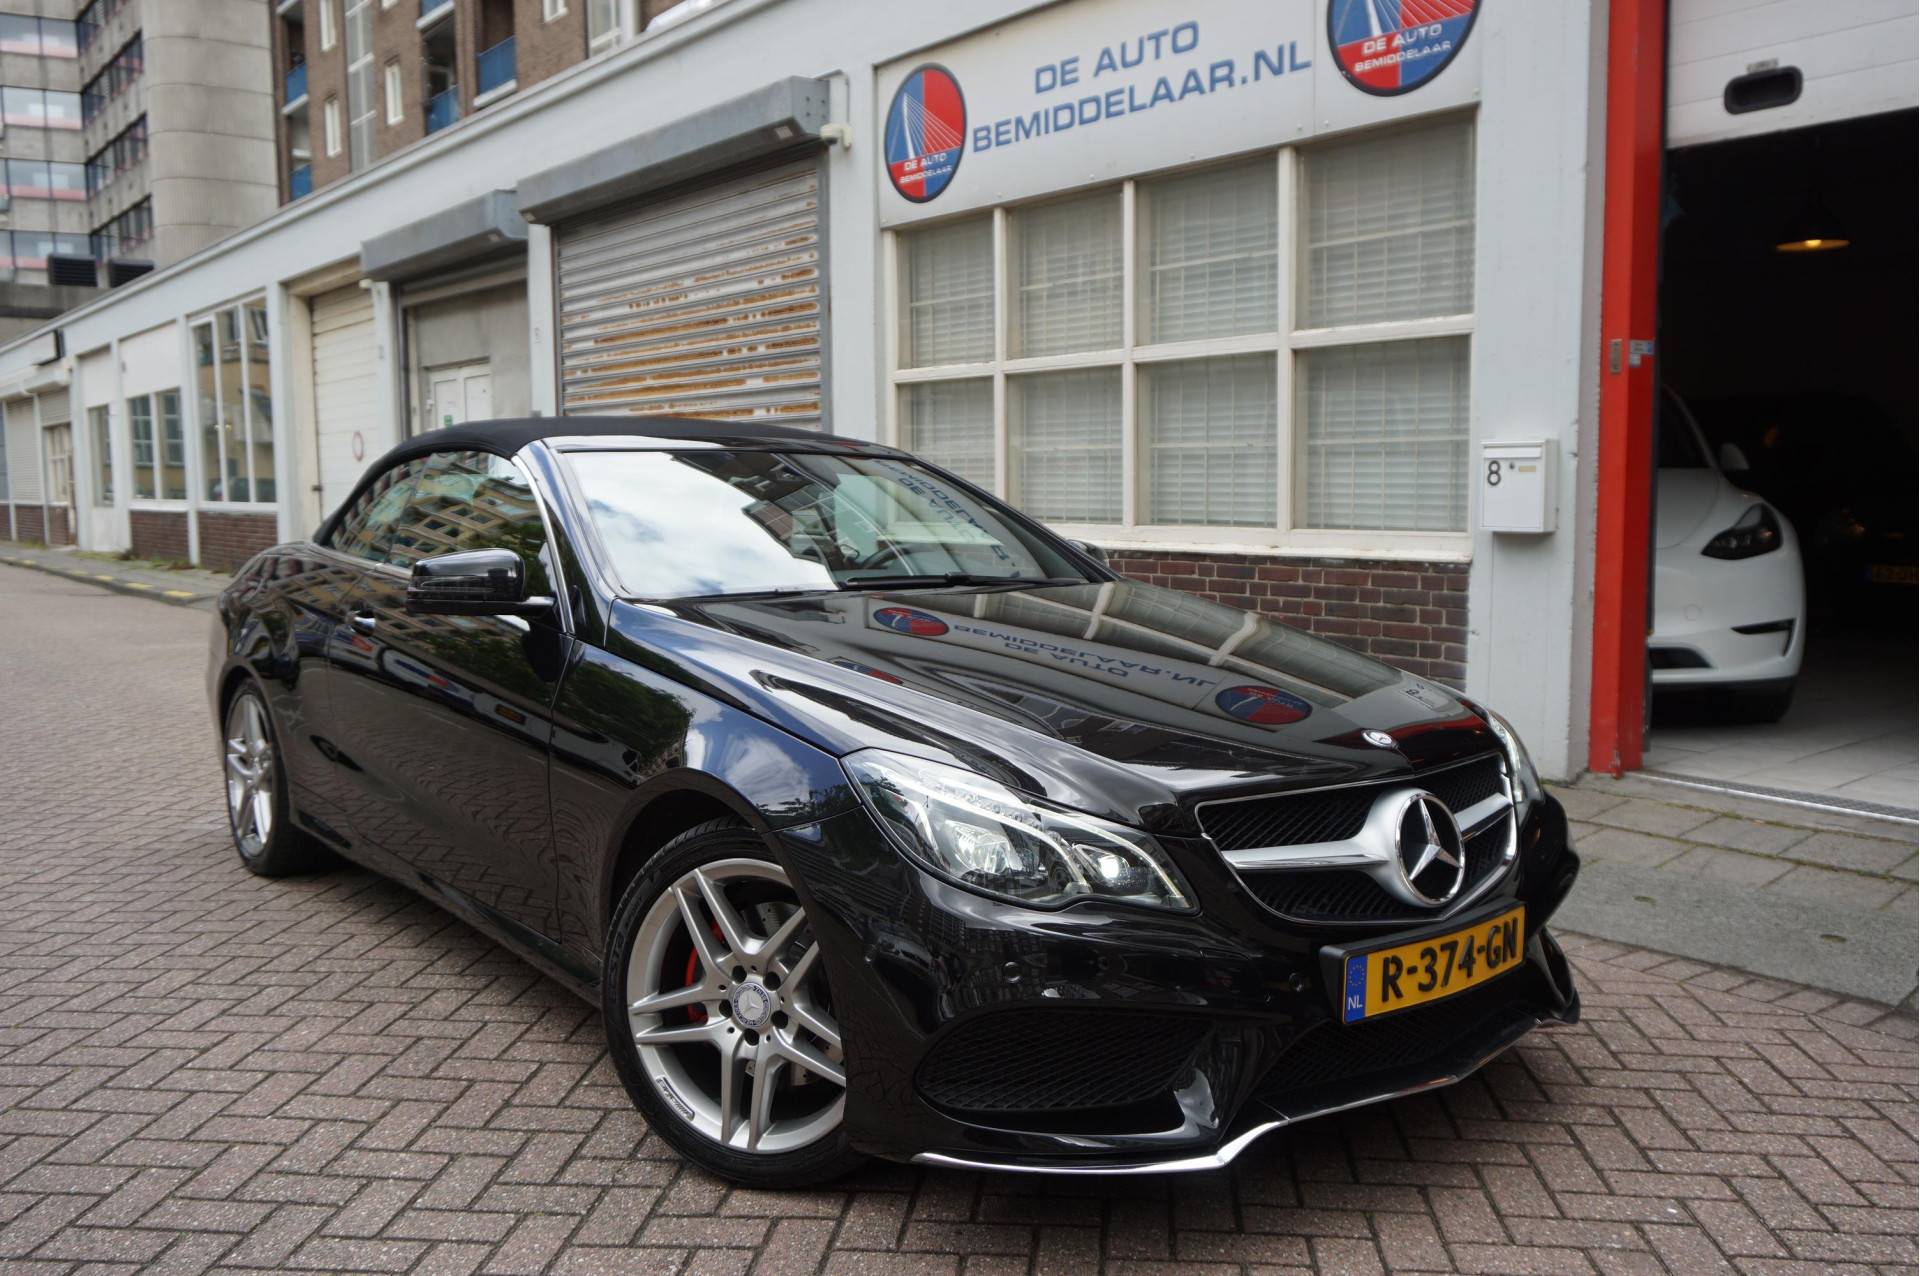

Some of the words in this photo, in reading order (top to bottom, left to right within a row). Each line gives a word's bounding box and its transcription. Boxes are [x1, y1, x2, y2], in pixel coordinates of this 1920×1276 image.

[1362, 37, 1387, 55] DE
[1392, 23, 1442, 47] AUTO
[1035, 55, 1080, 95] DE
[1093, 20, 1199, 78] AUTO
[1354, 41, 1451, 73] BEMIDDELAAR
[973, 40, 1312, 153] BEMIDDELAAR.NL
[904, 159, 918, 172] DE
[920, 152, 947, 168] AUTO
[1487, 459, 1501, 486] 8
[1381, 916, 1518, 1003] R-374-GN
[1347, 995, 1363, 1010] NL
